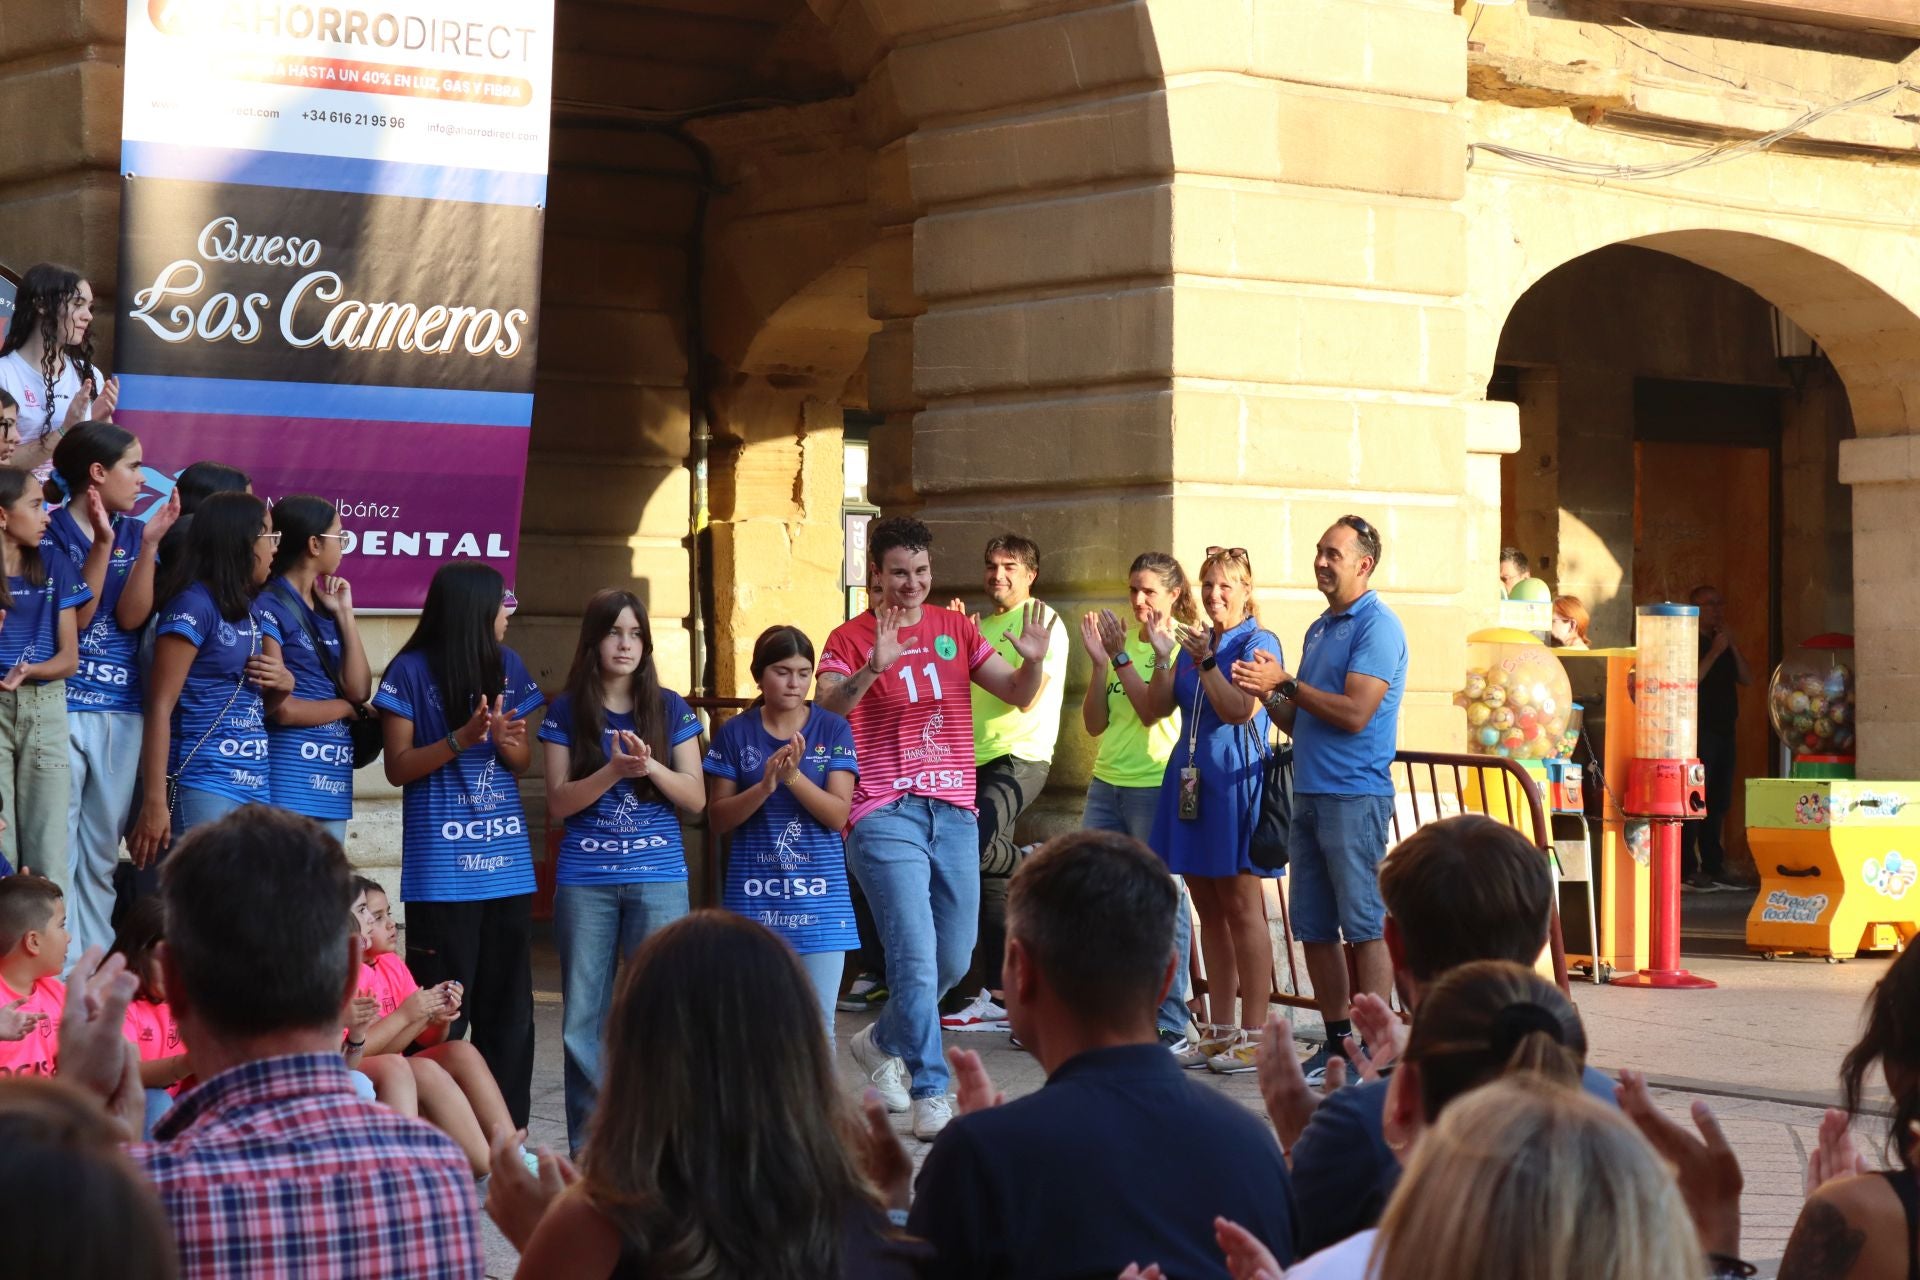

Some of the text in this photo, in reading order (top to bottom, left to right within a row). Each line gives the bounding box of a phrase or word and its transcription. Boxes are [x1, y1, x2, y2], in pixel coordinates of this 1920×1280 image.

[288, 63, 336, 81] HASTA
[339, 68, 359, 82] UN
[362, 70, 392, 87] 40%
[394, 75, 411, 88] EN
[443, 79, 470, 94] GAS
[473, 82, 483, 95] Y
[483, 83, 521, 98] FIBRA
[302, 109, 405, 129] +34 616 21 95 96
[197, 216, 322, 267] Queso
[129, 259, 528, 359] Los Cameros
[853, 520, 865, 546] GLS
[898, 662, 943, 704] 11
[460, 854, 506, 872] Muga
[762, 910, 810, 928] Muga
